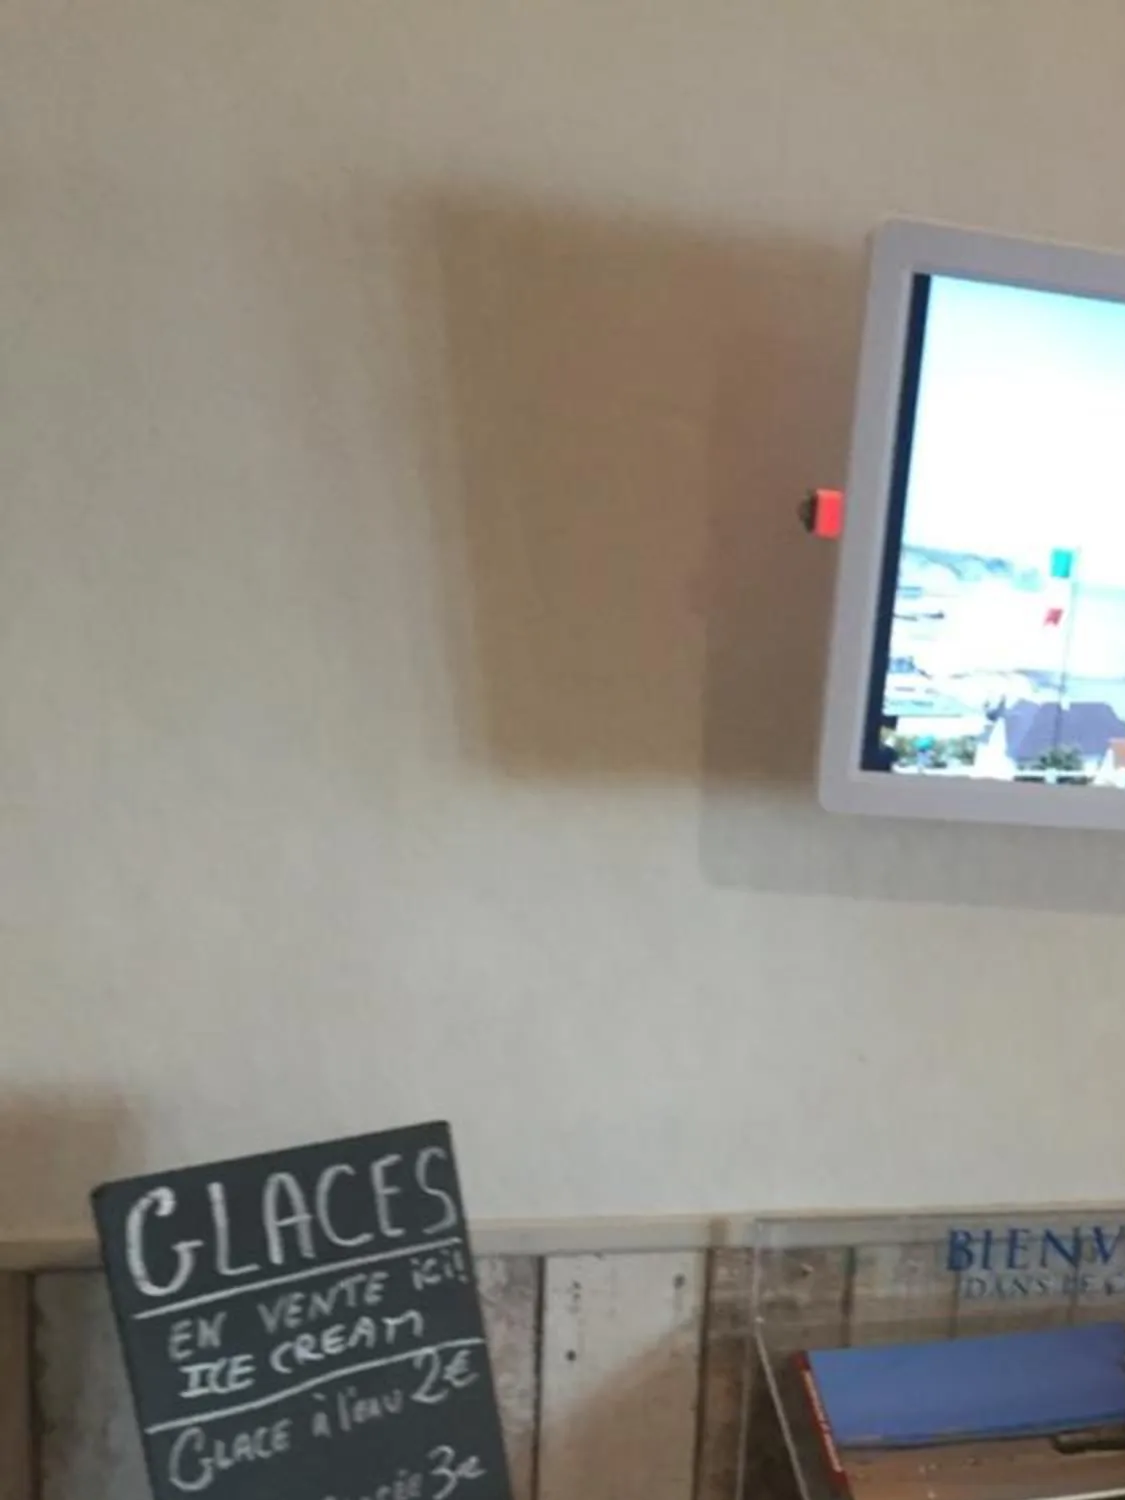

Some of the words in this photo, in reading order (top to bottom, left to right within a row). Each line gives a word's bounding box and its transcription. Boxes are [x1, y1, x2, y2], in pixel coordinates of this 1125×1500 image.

[125, 1146, 460, 1298] GLACES
[168, 1312, 227, 1361] EN
[257, 1271, 389, 1334] VENTE
[962, 1273, 1050, 1300] DANS
[178, 1354, 256, 1398] ICE
[269, 1309, 423, 1373] CREAM
[169, 1419, 292, 1492] GLACE
[411, 1349, 480, 1403] 2€
